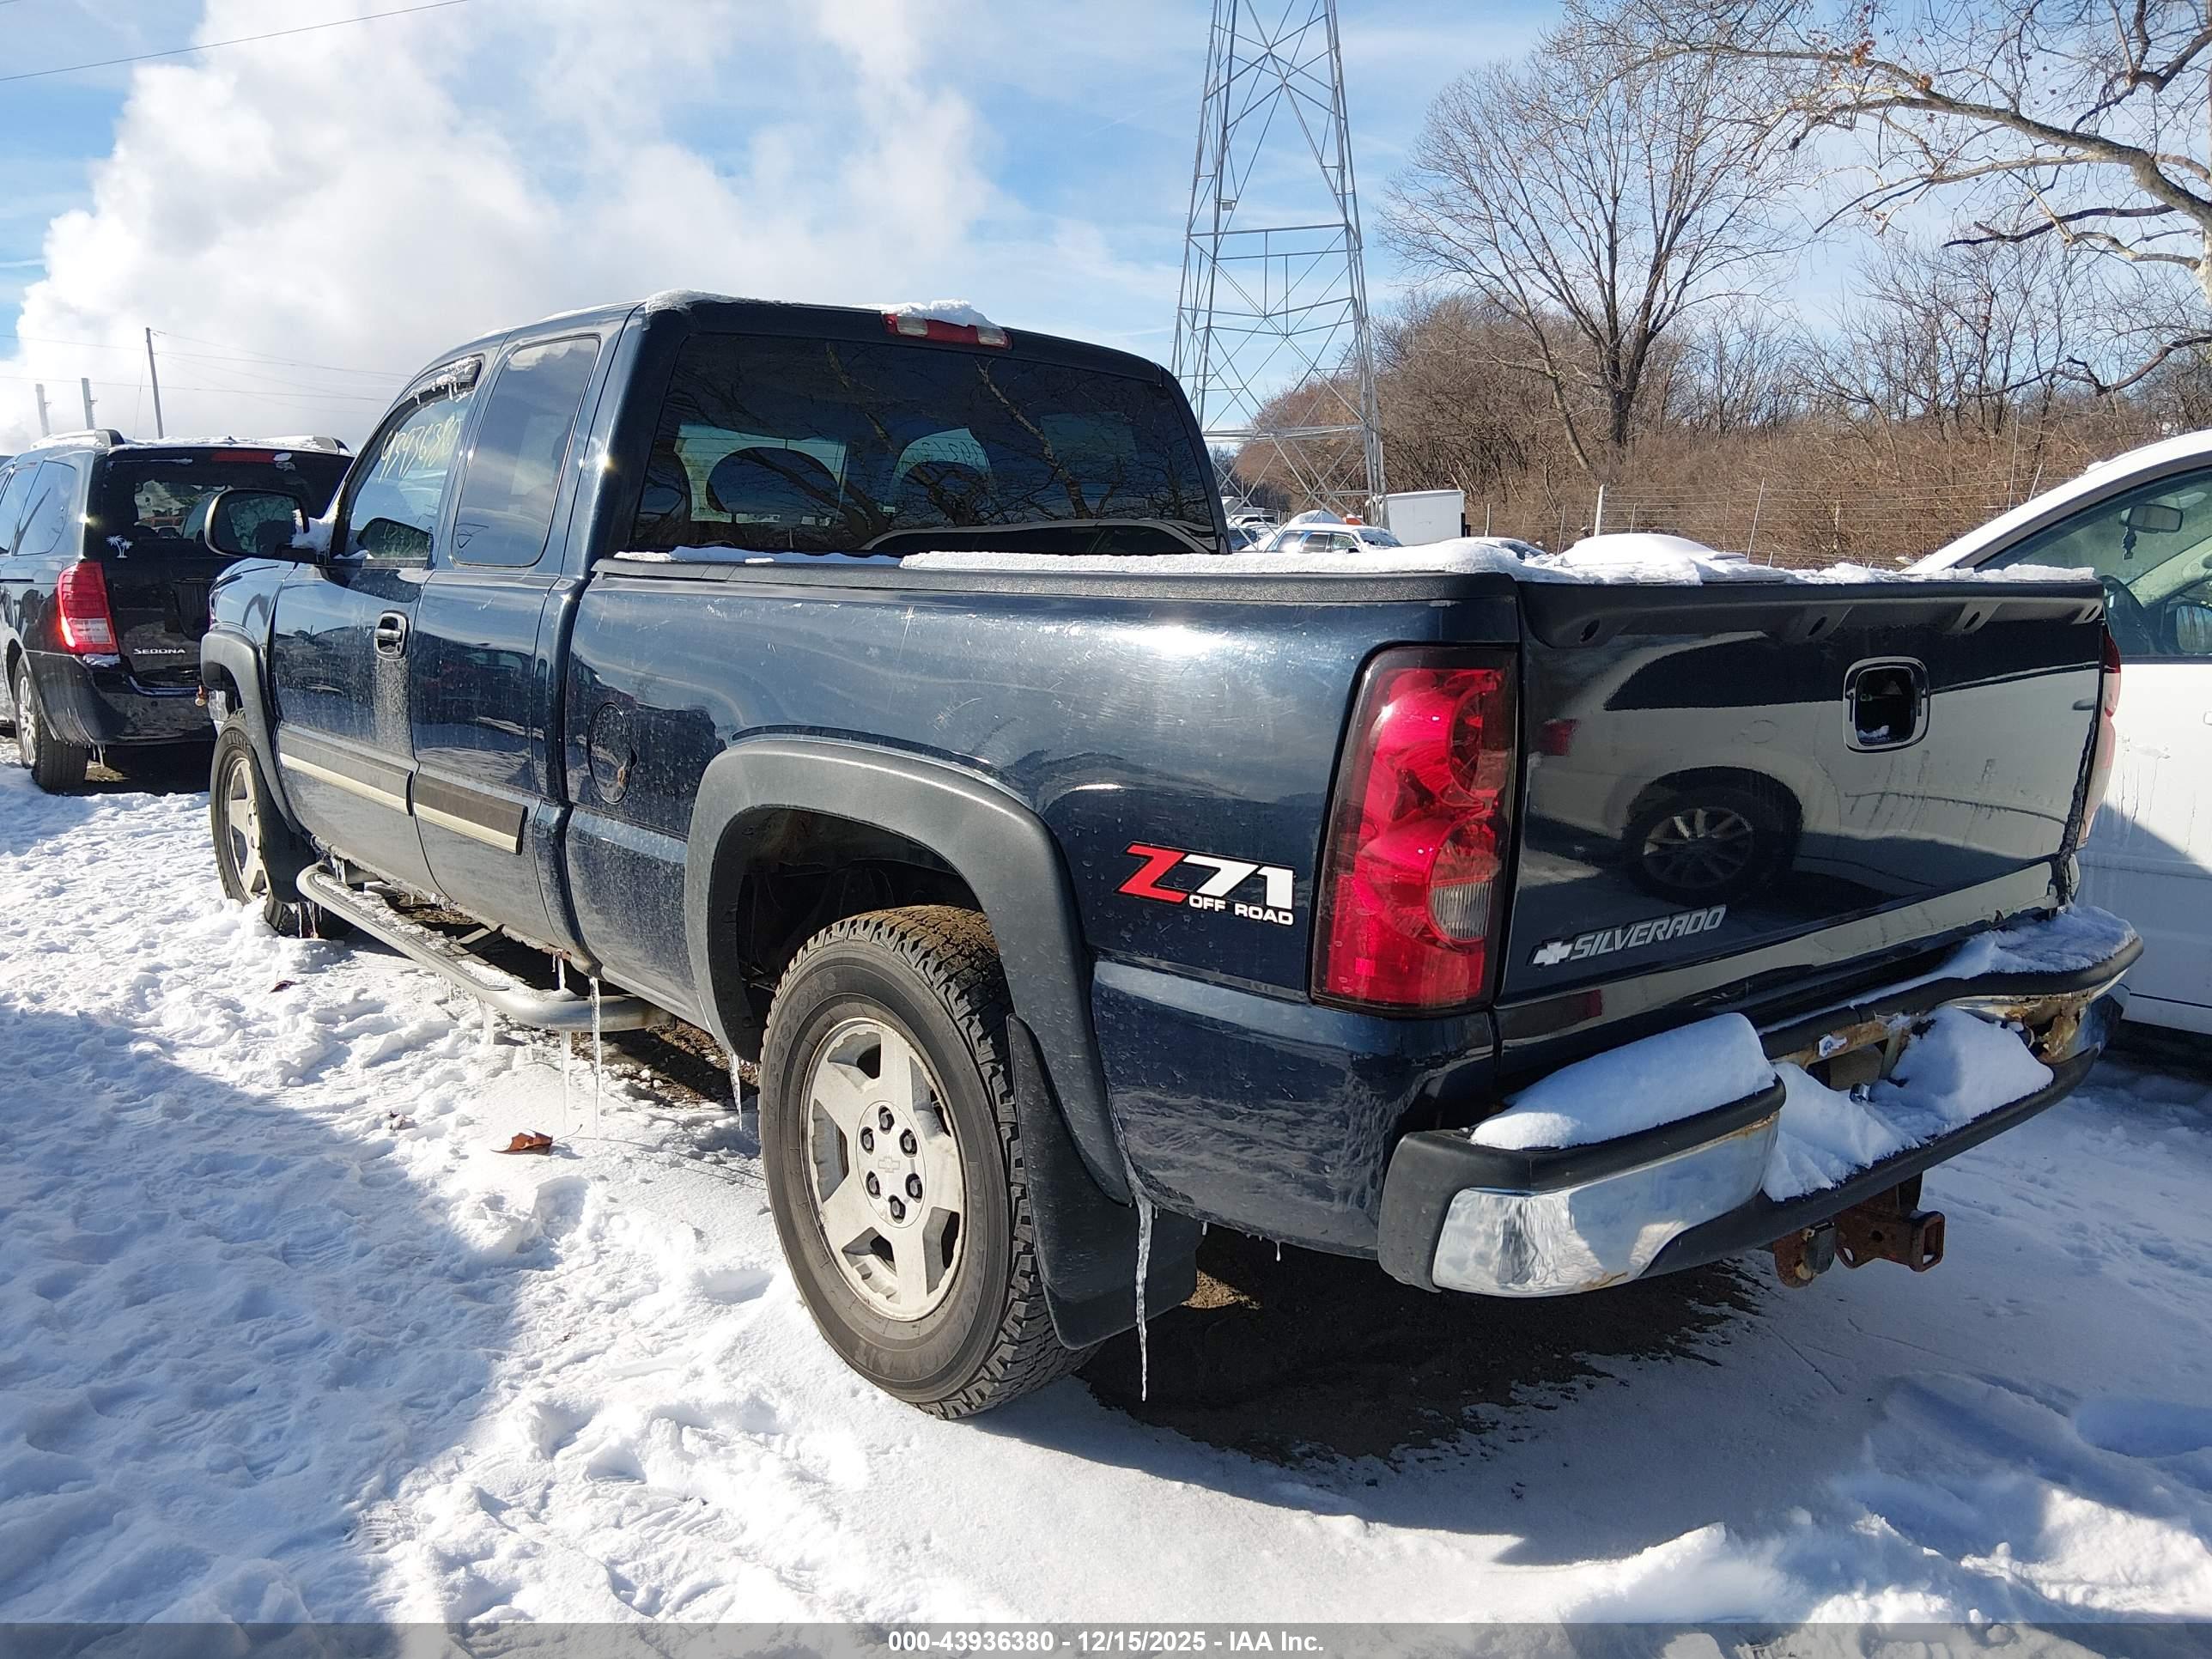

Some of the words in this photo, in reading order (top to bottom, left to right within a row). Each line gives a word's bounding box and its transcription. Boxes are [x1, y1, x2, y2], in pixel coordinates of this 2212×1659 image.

[1118, 842, 1293, 910] Z71
[1188, 894, 1226, 913] OFF
[1235, 903, 1294, 926] ROAD
[1570, 904, 1727, 961] SILVERADO
